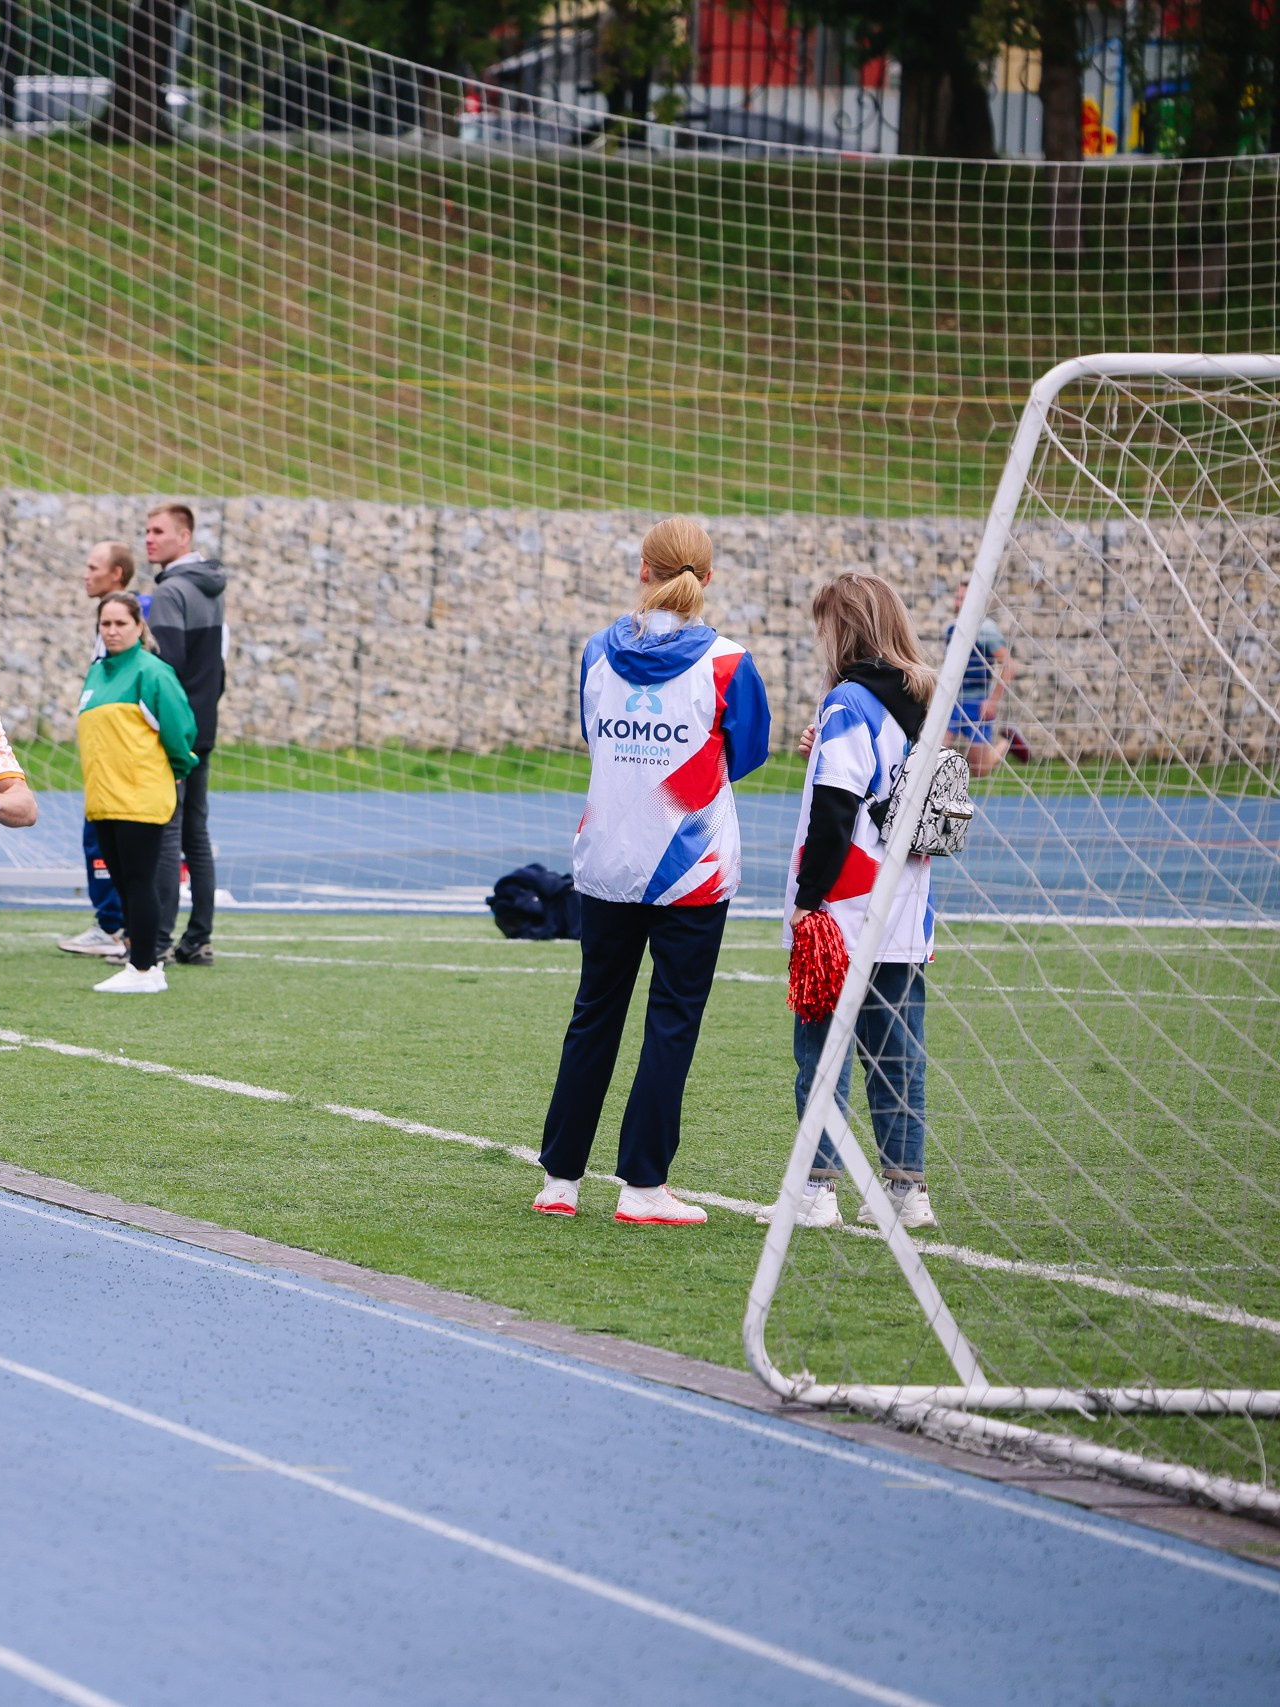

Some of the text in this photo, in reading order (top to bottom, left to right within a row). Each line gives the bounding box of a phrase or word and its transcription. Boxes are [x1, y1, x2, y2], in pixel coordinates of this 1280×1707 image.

[598, 718, 689, 743] КОМОС
[615, 743, 671, 757] МИЛКОМ
[614, 756, 670, 766] ИЖМОЛОКО
